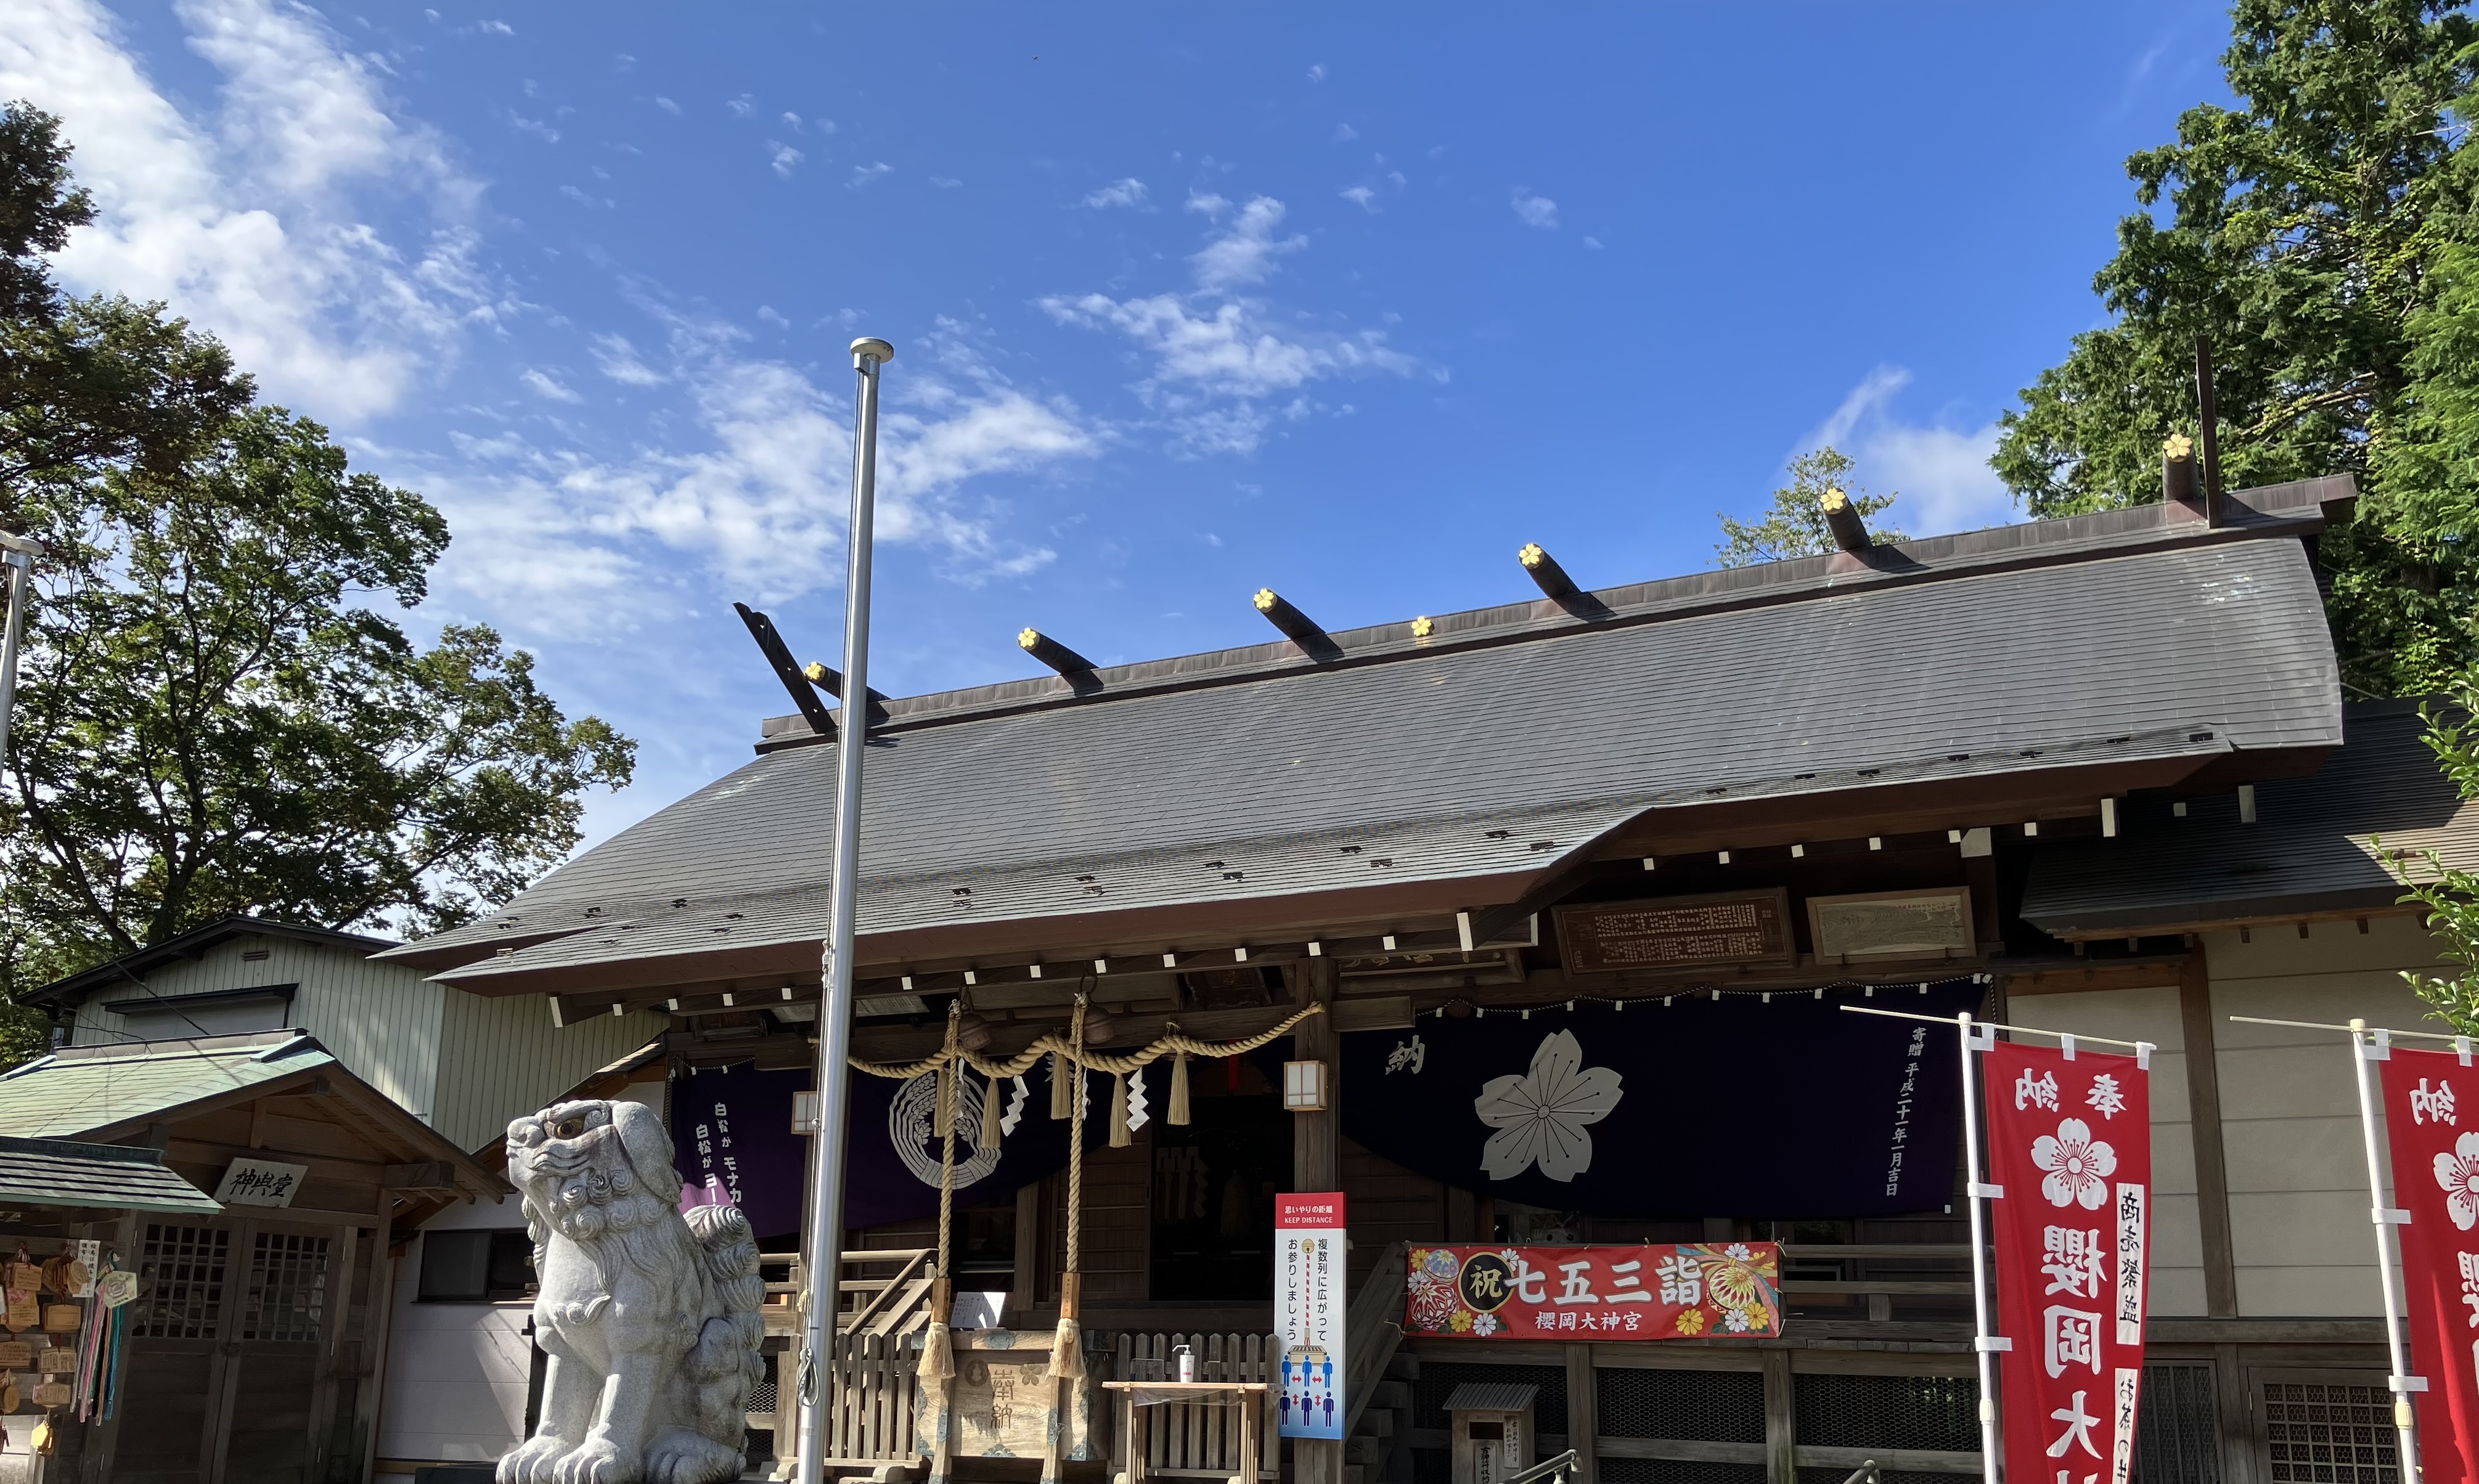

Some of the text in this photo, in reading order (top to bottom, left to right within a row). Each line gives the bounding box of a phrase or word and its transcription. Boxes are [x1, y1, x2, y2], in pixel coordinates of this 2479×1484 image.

[1385, 1035, 1426, 1075] 納
[1886, 1027, 1927, 1197] 寄贈 平成二十一年一月吉日
[696, 1124, 717, 1206] 白松がヨー
[1284, 1205, 1333, 1214] 思いやりの距離
[1287, 1239, 1298, 1340] お参りしましょう
[1317, 1238, 1328, 1341] 複数列に広がって
[1469, 1255, 1704, 1306] 祝 七五三詣
[1535, 1310, 1642, 1331] 櫻岡大神宮
